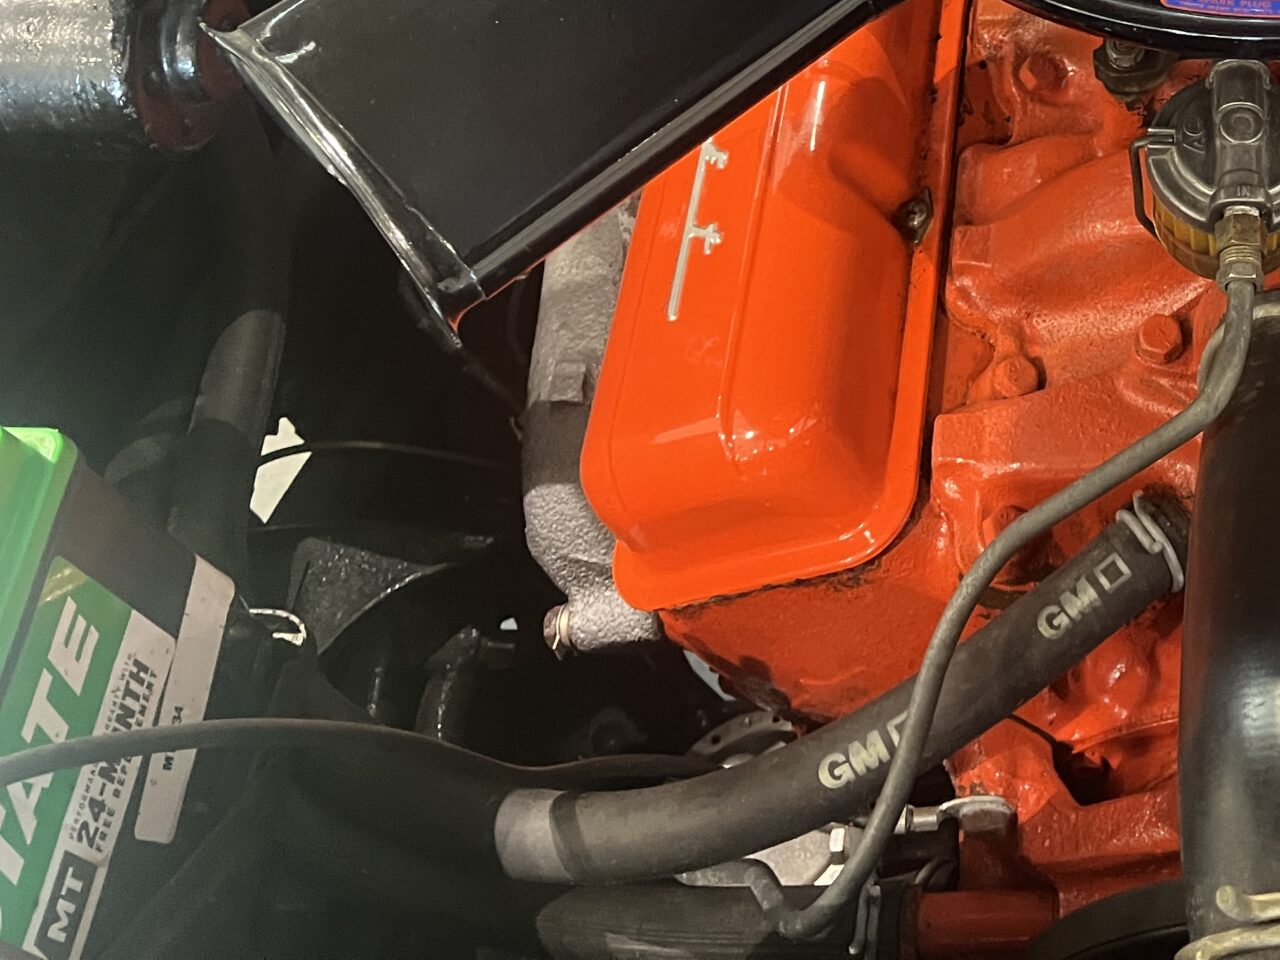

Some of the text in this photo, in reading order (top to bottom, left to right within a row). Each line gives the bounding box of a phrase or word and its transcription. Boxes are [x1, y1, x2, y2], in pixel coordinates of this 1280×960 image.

[1236, 185, 1250, 197] IN
[1036, 575, 1102, 640] GM
[0, 595, 99, 932] TATE
[76, 658, 150, 851] 24-MNTH
[112, 668, 157, 799] REPLEMENT
[817, 729, 891, 790] GM
[47, 866, 83, 943] MT
